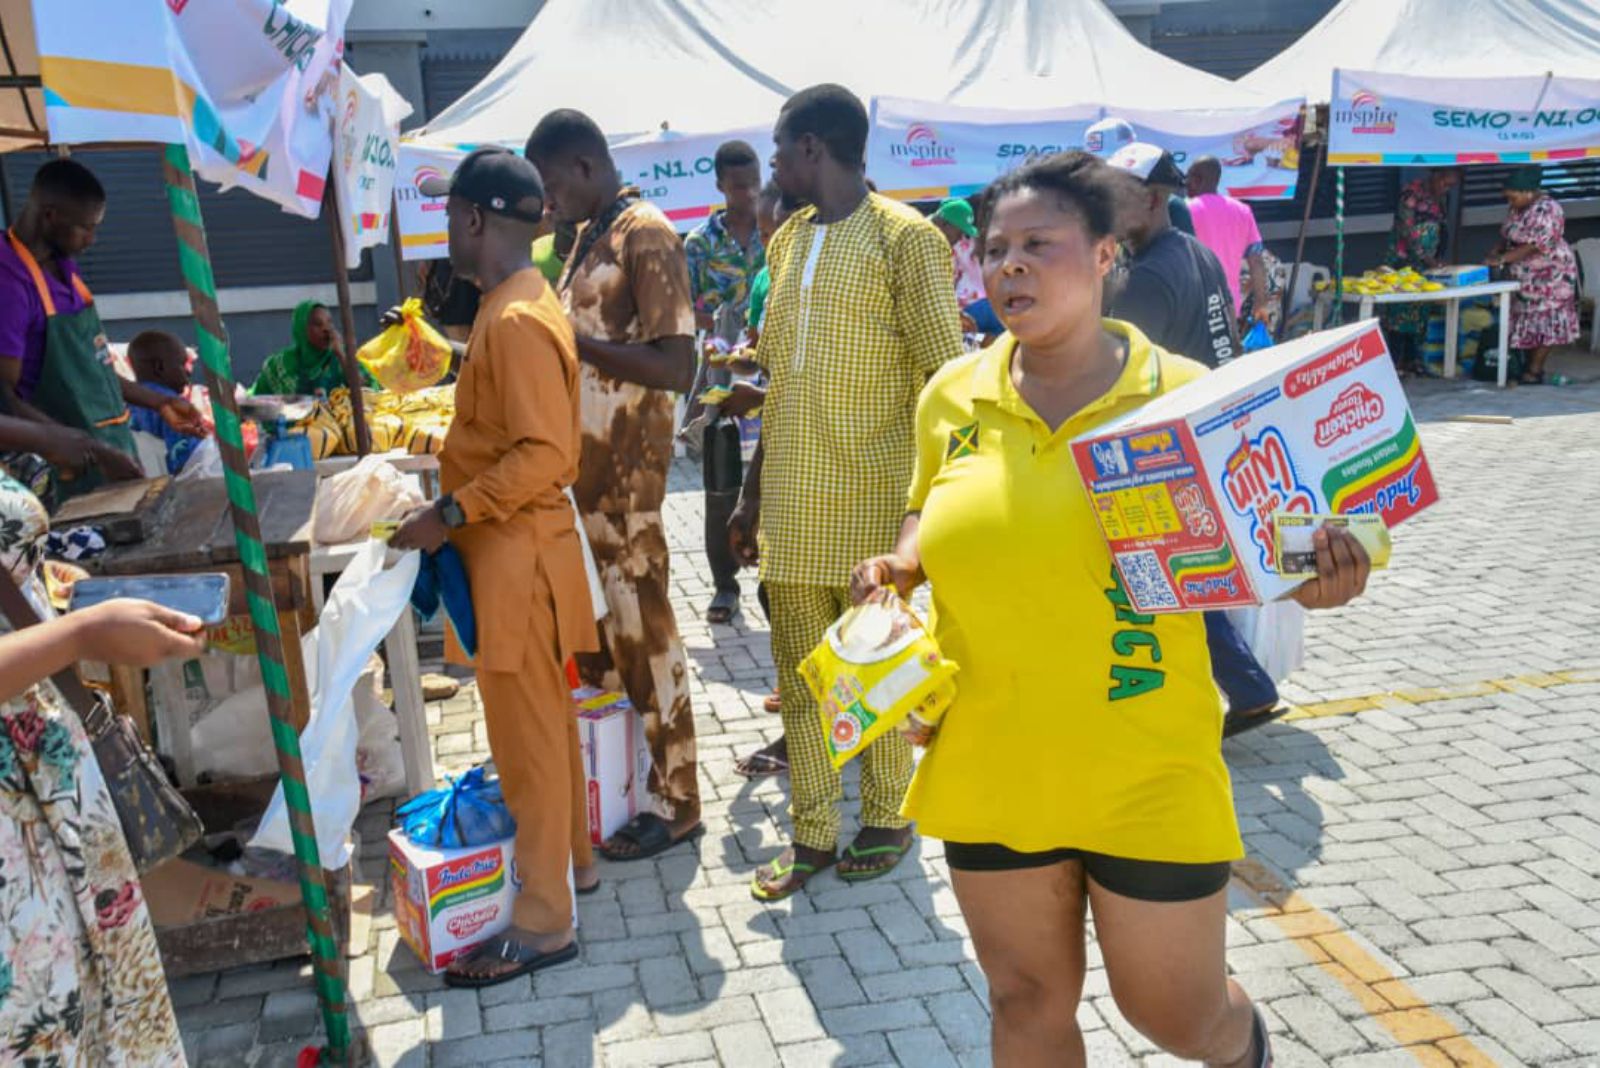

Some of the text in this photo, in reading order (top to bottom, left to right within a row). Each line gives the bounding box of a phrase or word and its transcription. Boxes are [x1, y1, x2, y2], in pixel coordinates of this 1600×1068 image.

[1433, 110, 1511, 129] SEMO
[653, 156, 715, 180] N1,0
[1333, 391, 1362, 415] Flavor
[1319, 396, 1381, 440] Chicken
[1228, 436, 1291, 510] Win
[1258, 494, 1280, 519] and
